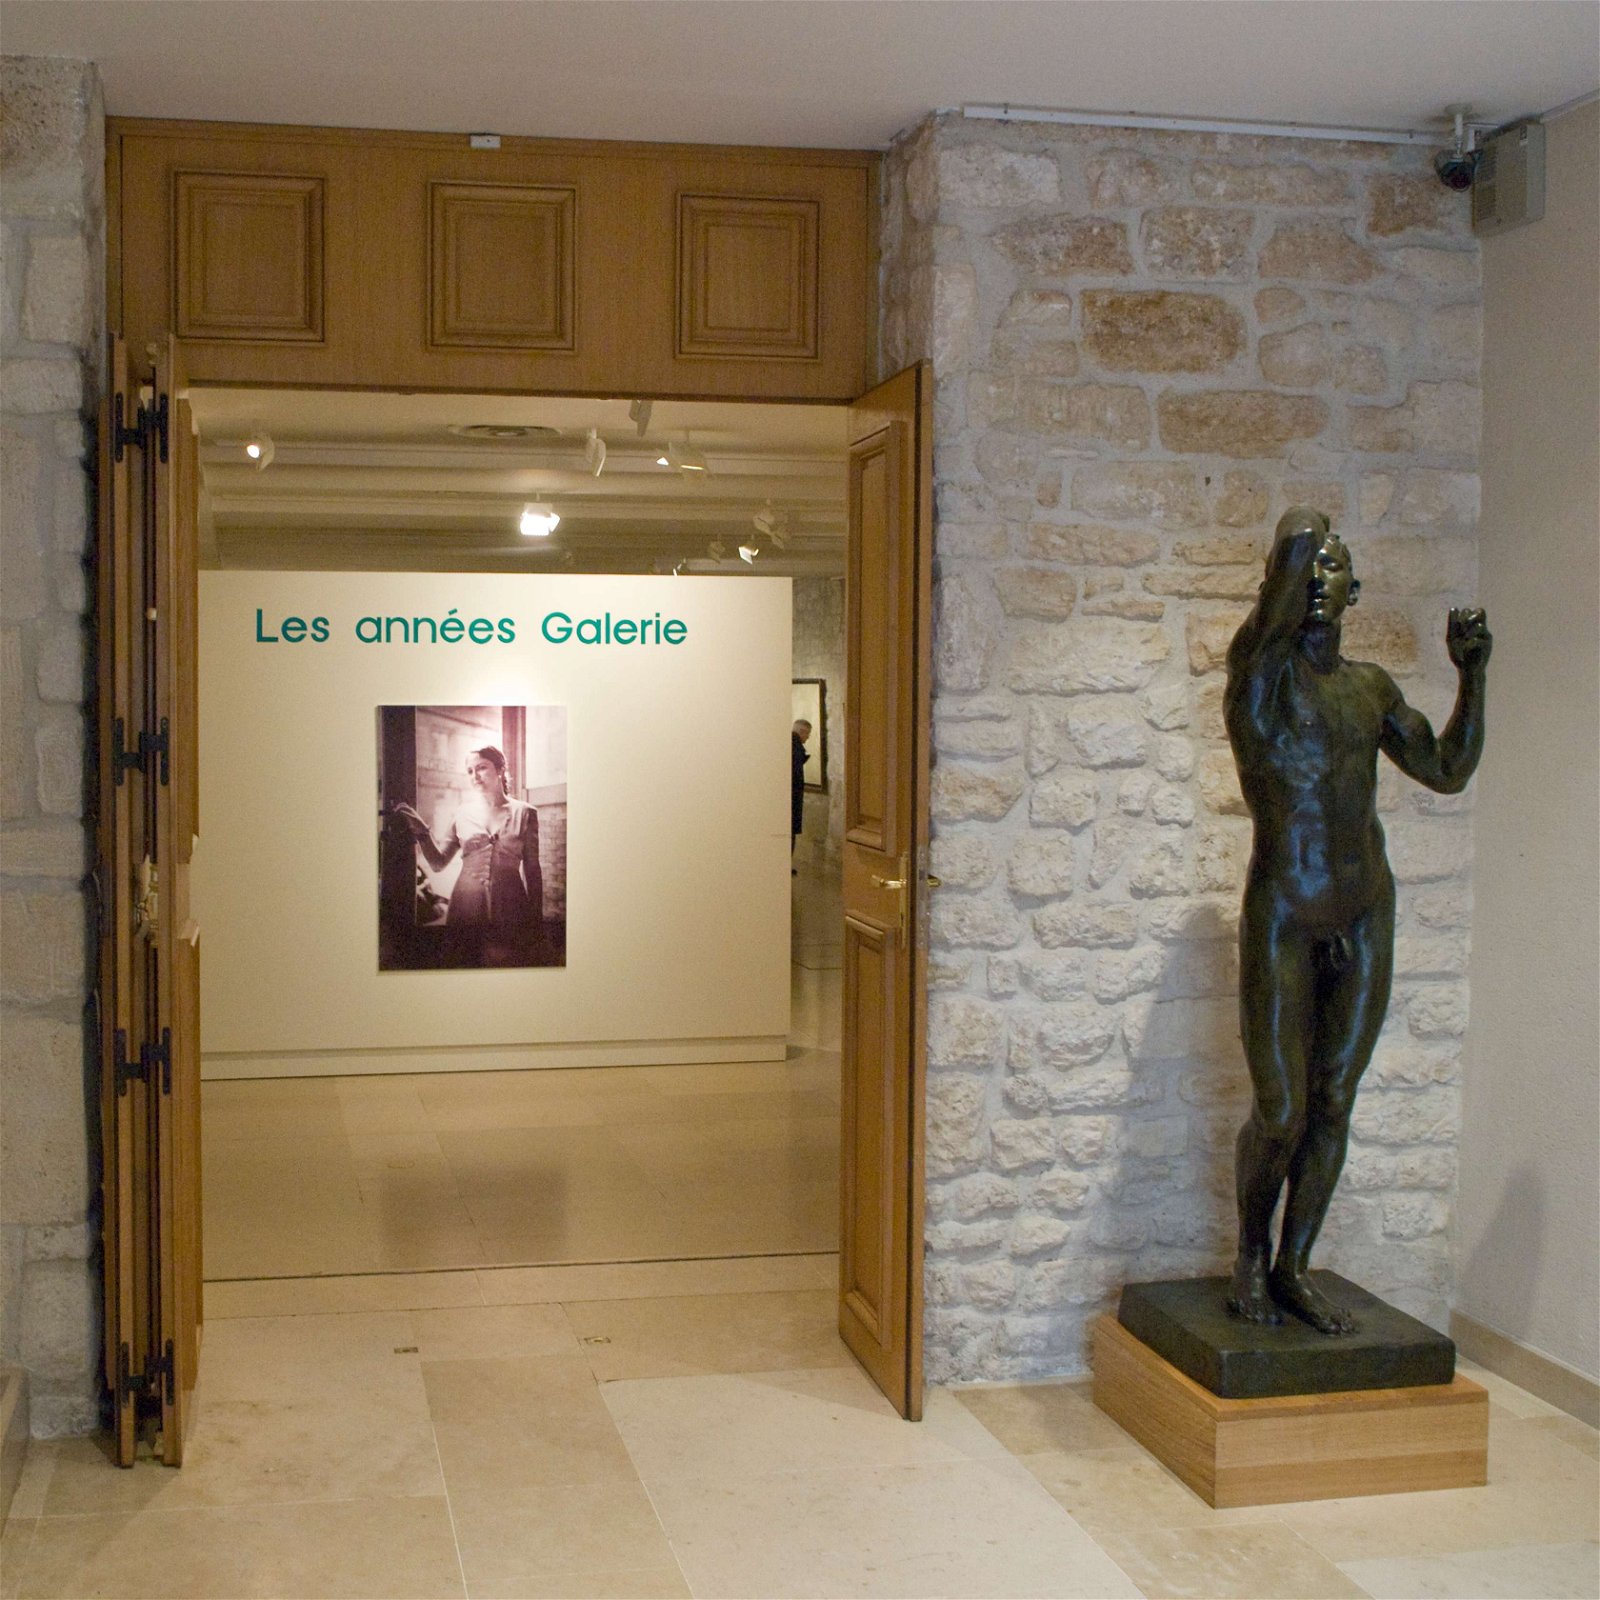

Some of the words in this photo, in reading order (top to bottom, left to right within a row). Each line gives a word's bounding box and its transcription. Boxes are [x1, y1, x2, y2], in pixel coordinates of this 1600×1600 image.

[256, 607, 330, 644] Les
[354, 606, 518, 645] années
[540, 610, 689, 646] Galerie
